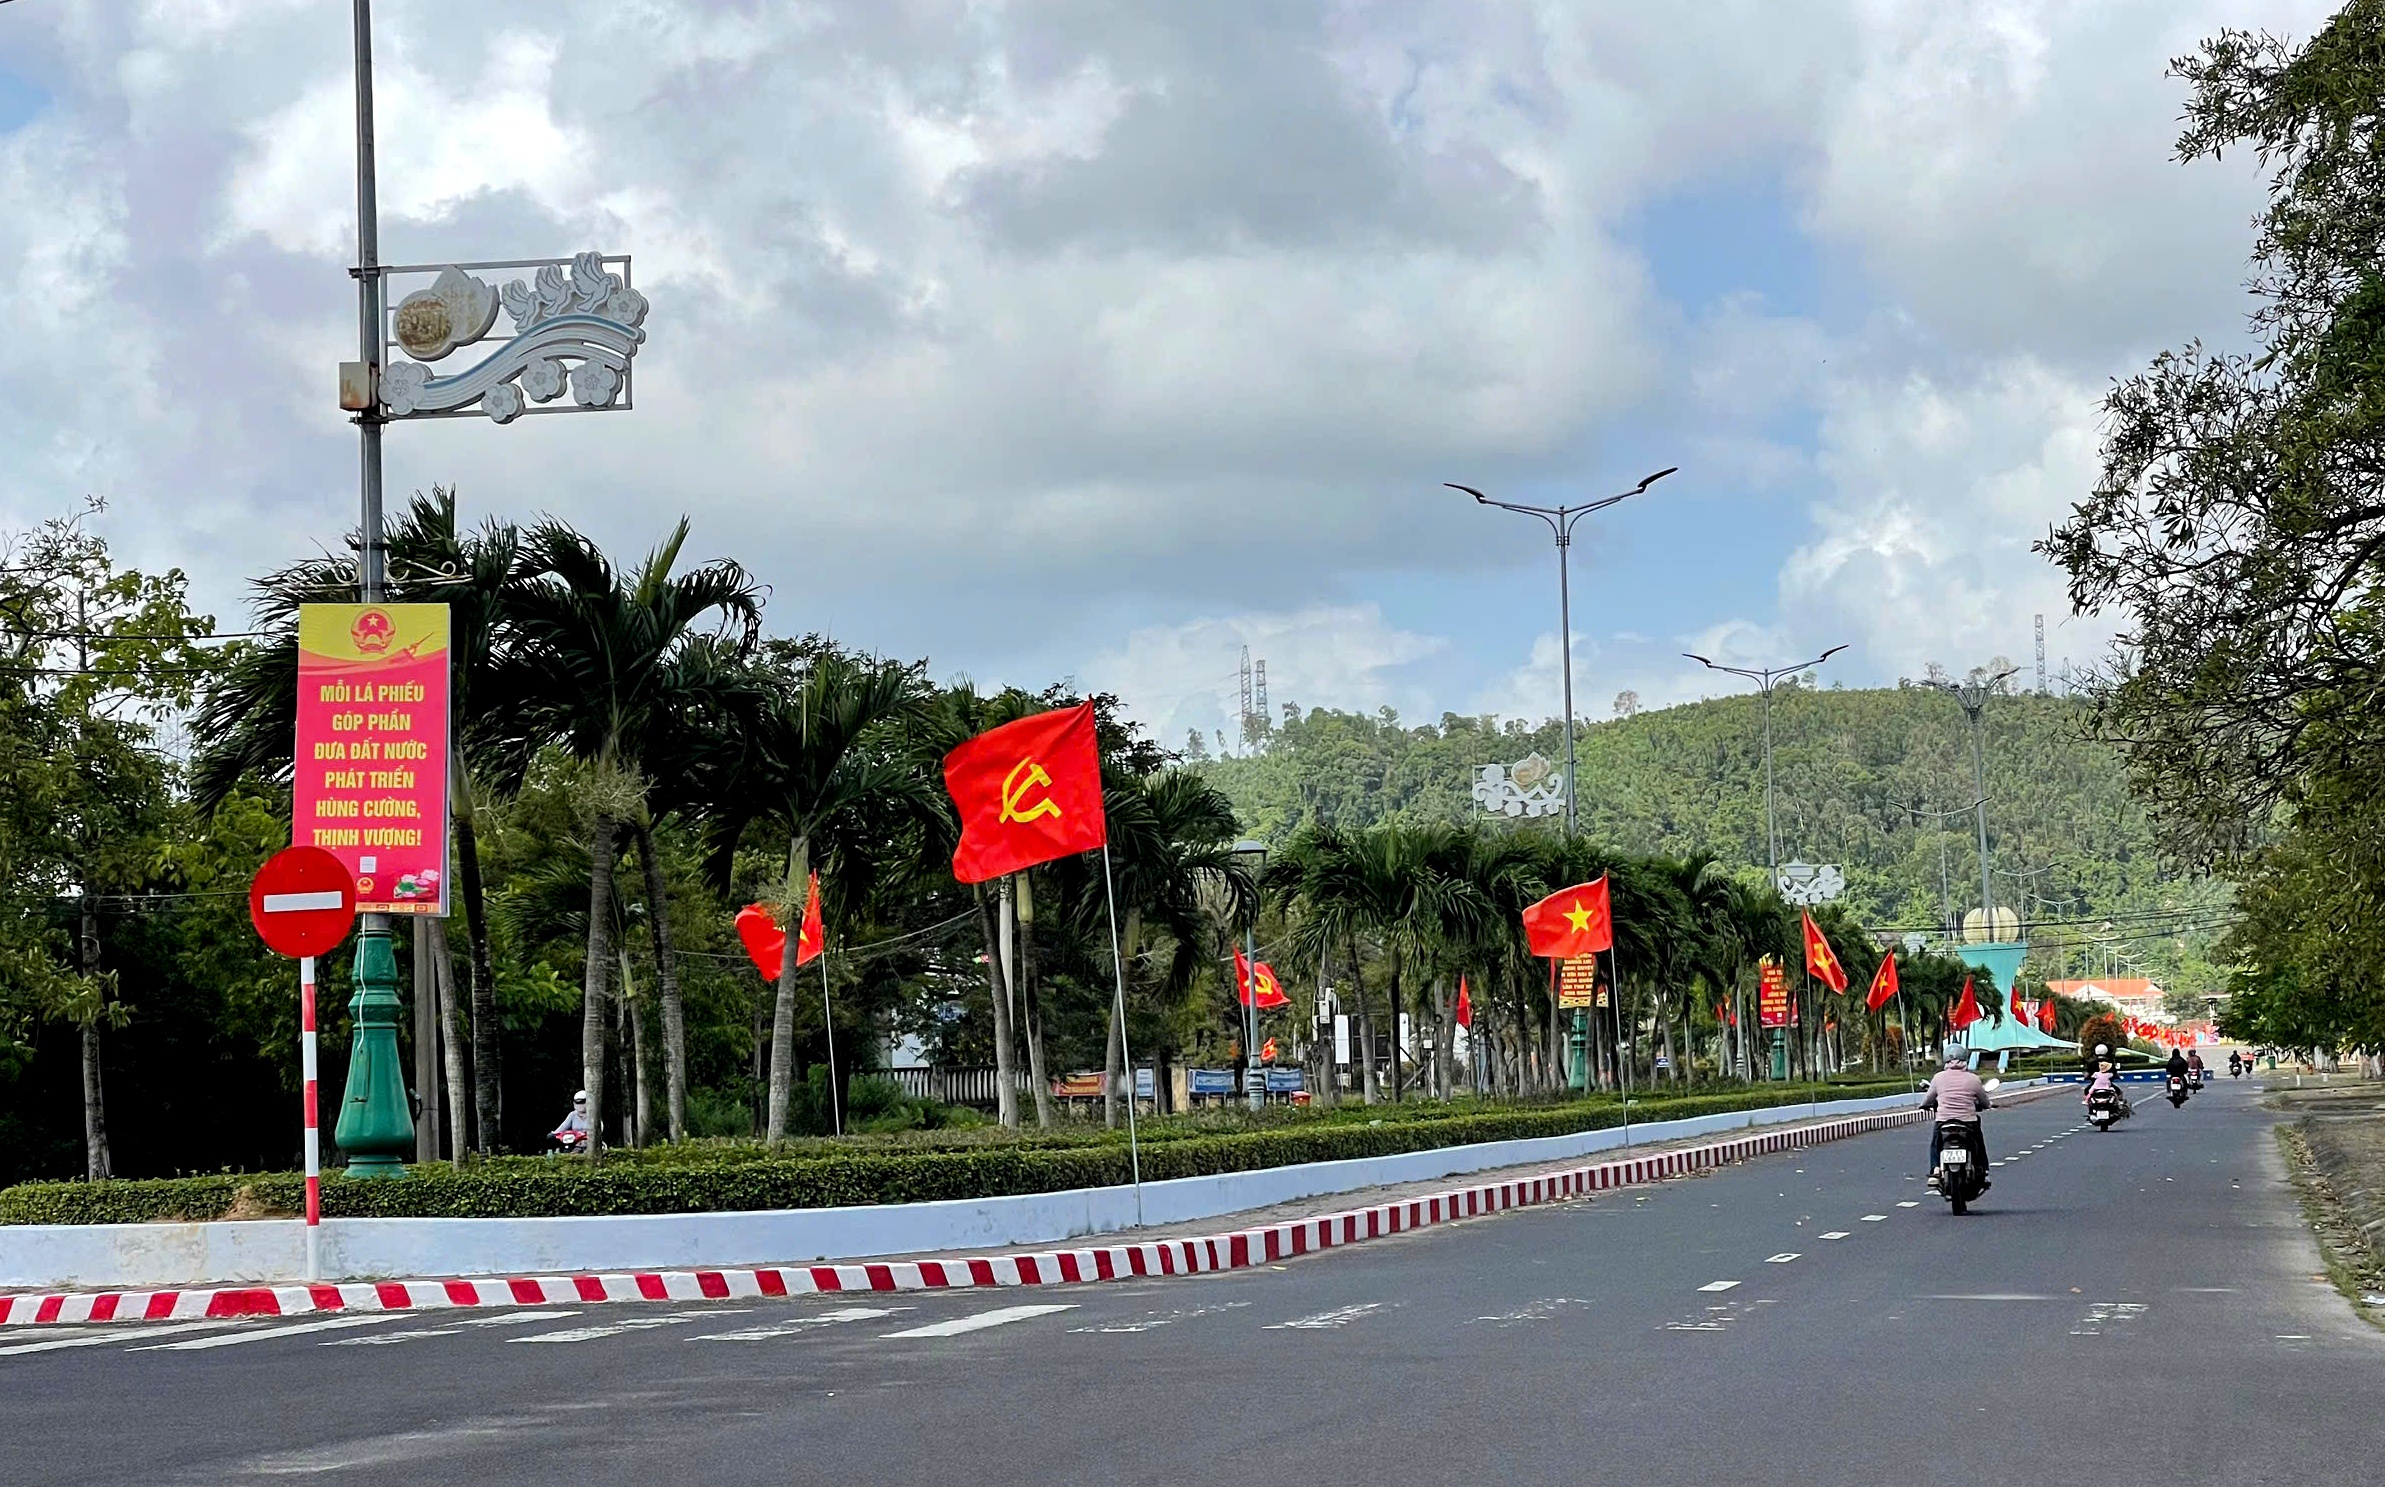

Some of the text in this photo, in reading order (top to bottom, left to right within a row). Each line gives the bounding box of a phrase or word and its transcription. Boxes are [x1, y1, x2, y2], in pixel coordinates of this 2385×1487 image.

[355, 682, 373, 702] LÁ
[379, 680, 424, 702] PHIẾU
[333, 709, 410, 730] GÓP PHẦN
[314, 737, 426, 759] ĐƯA ĐẤT NƯỚC
[325, 765, 414, 788] PHÁT TRIỂN
[316, 797, 359, 817] HÙNG
[313, 828, 421, 849] THỊNH VƯỢNG!
